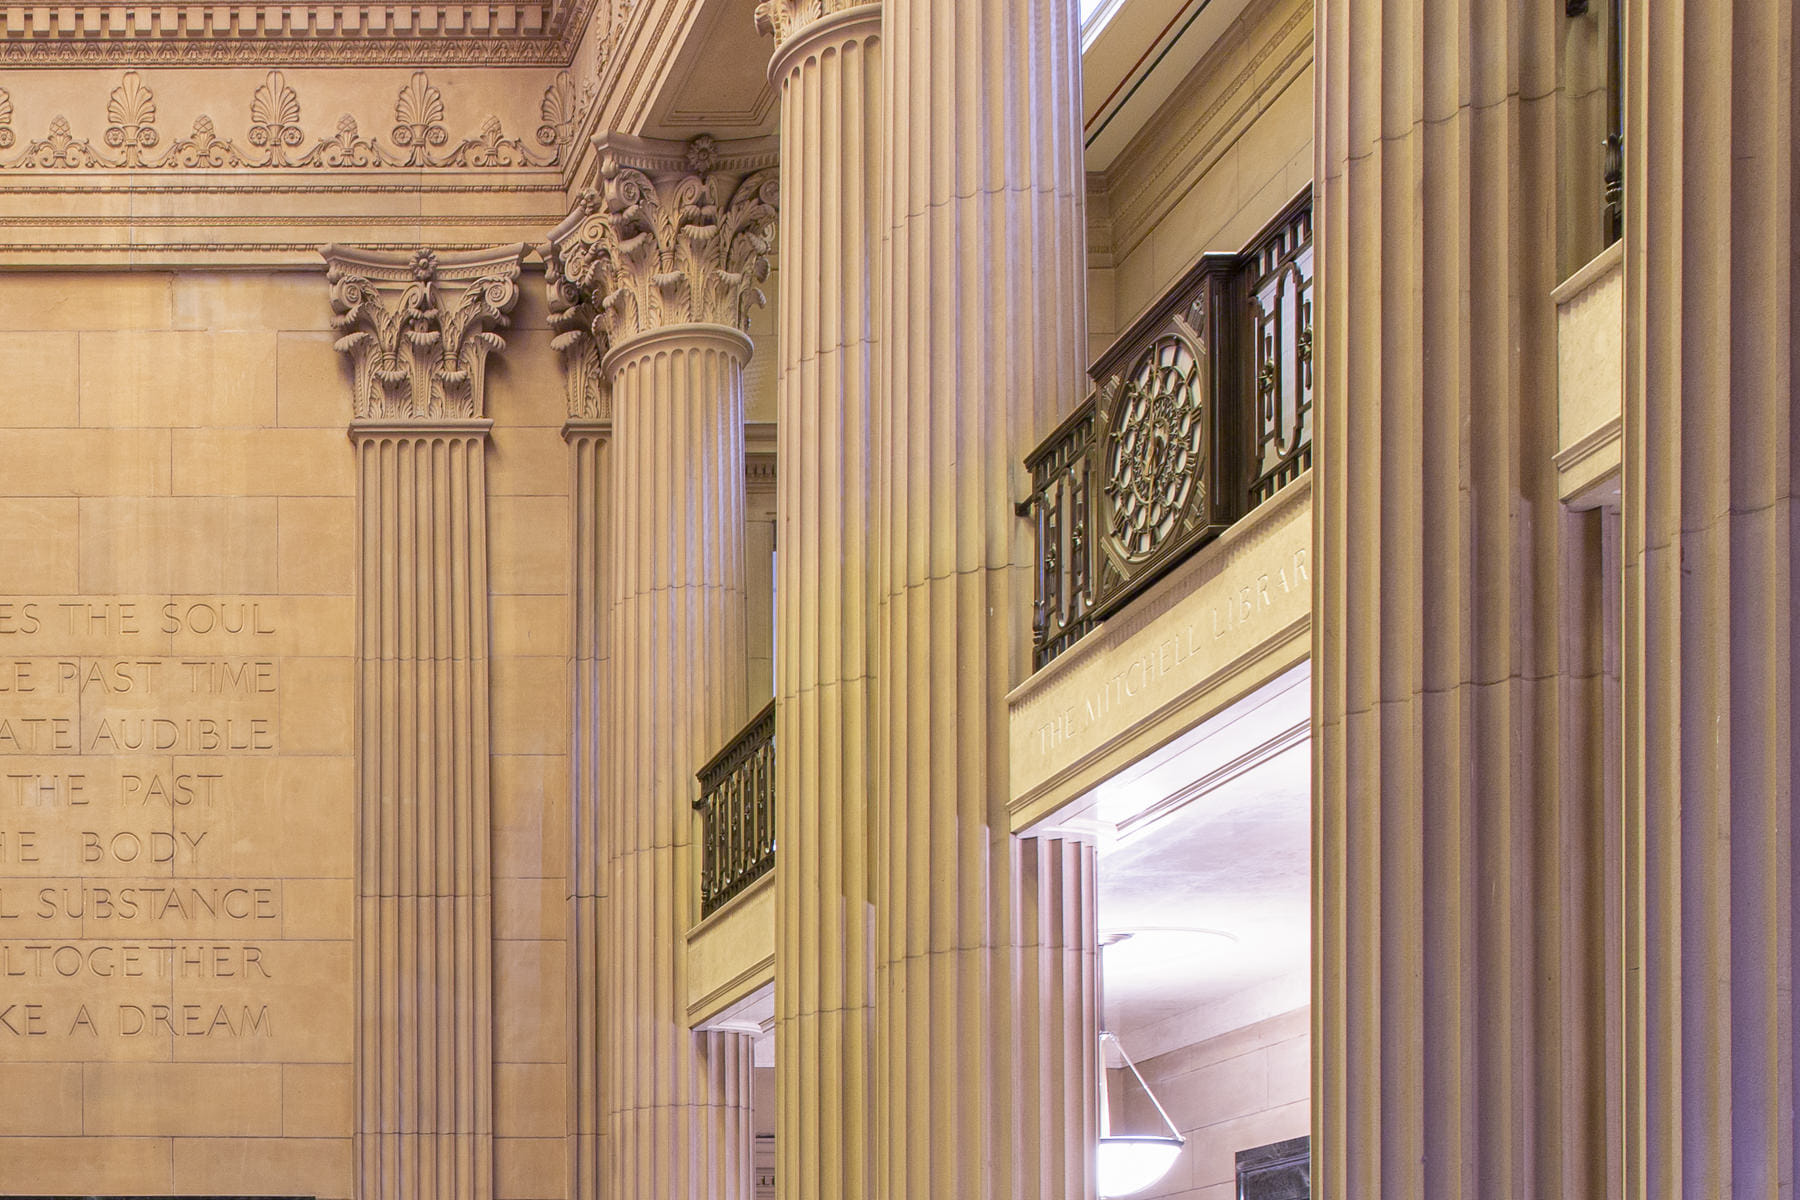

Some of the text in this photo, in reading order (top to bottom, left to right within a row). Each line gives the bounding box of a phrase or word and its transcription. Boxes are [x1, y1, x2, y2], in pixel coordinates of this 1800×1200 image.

[58, 603, 140, 636] THE
[160, 603, 276, 636] SOUL
[1038, 549, 1309, 755] THE MITCHELL LIBRAR
[57, 660, 163, 694] PAST
[180, 660, 276, 694] TIME
[89, 717, 274, 751] AUDIBLE
[6, 773, 91, 807] THE
[120, 773, 224, 807] PAST
[80, 831, 209, 864] BODY
[35, 886, 277, 921] SUBSTANCE
[68, 1002, 99, 1038] A
[119, 1002, 273, 1038] DREAM
